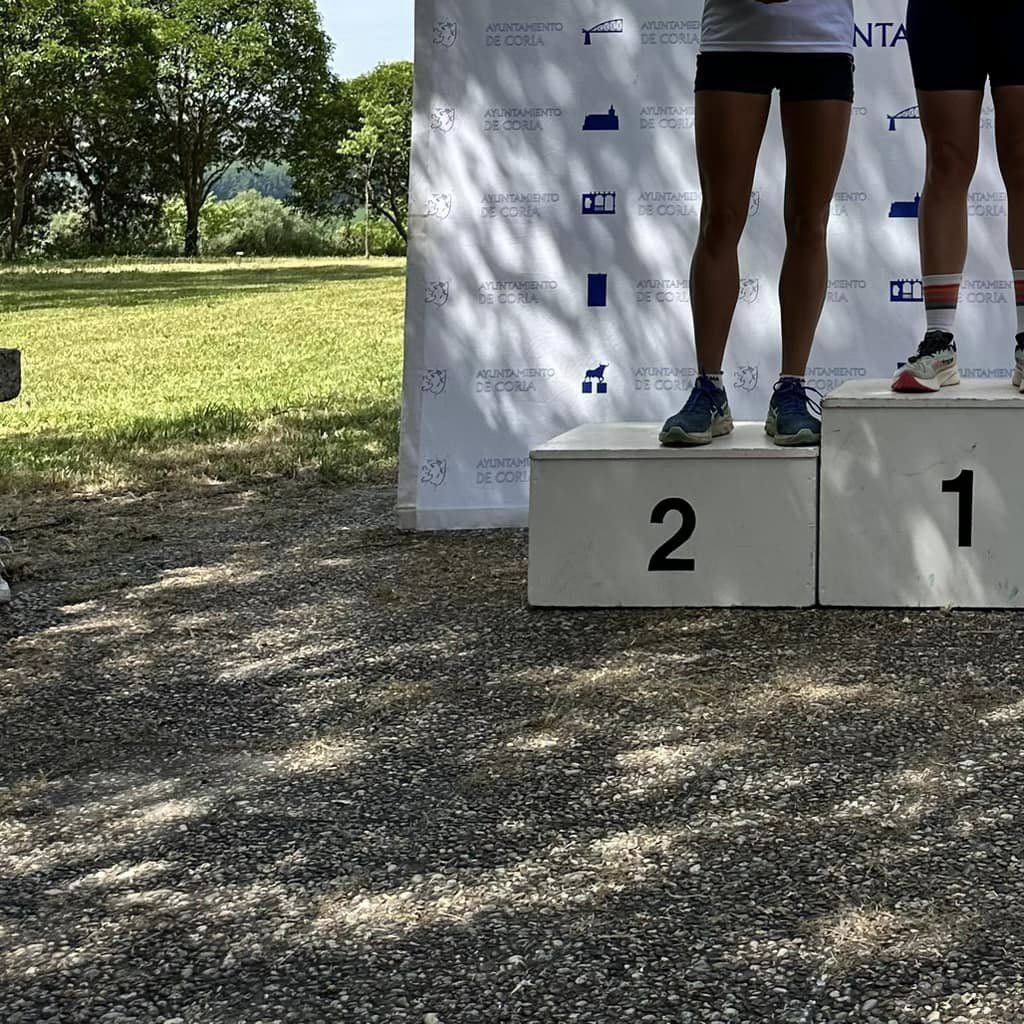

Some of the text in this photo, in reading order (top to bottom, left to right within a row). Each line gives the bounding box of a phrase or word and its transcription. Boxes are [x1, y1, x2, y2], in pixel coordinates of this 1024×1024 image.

[486, 22, 563, 33] AYUNTAMIENTO
[486, 35, 544, 46] DE CORIA
[641, 33, 655, 45] DE
[484, 107, 562, 118] AYUNTAMIENTO
[484, 120, 543, 131] DE CORIA
[640, 118, 654, 130] DE
[482, 192, 559, 203] AYUNTAMIENTO
[481, 206, 540, 218] DE CORIA
[639, 205, 653, 216] DE
[479, 280, 558, 290] AYUNTAMIENTO
[479, 293, 538, 304] DE CORIA
[636, 291, 650, 303] DE
[476, 368, 555, 378] AYUNTAMIENTO
[476, 381, 536, 393] DE CORIA
[635, 379, 649, 391] DE
[476, 471, 490, 484] DE
[942, 470, 974, 547] 1
[648, 497, 696, 572] 2
